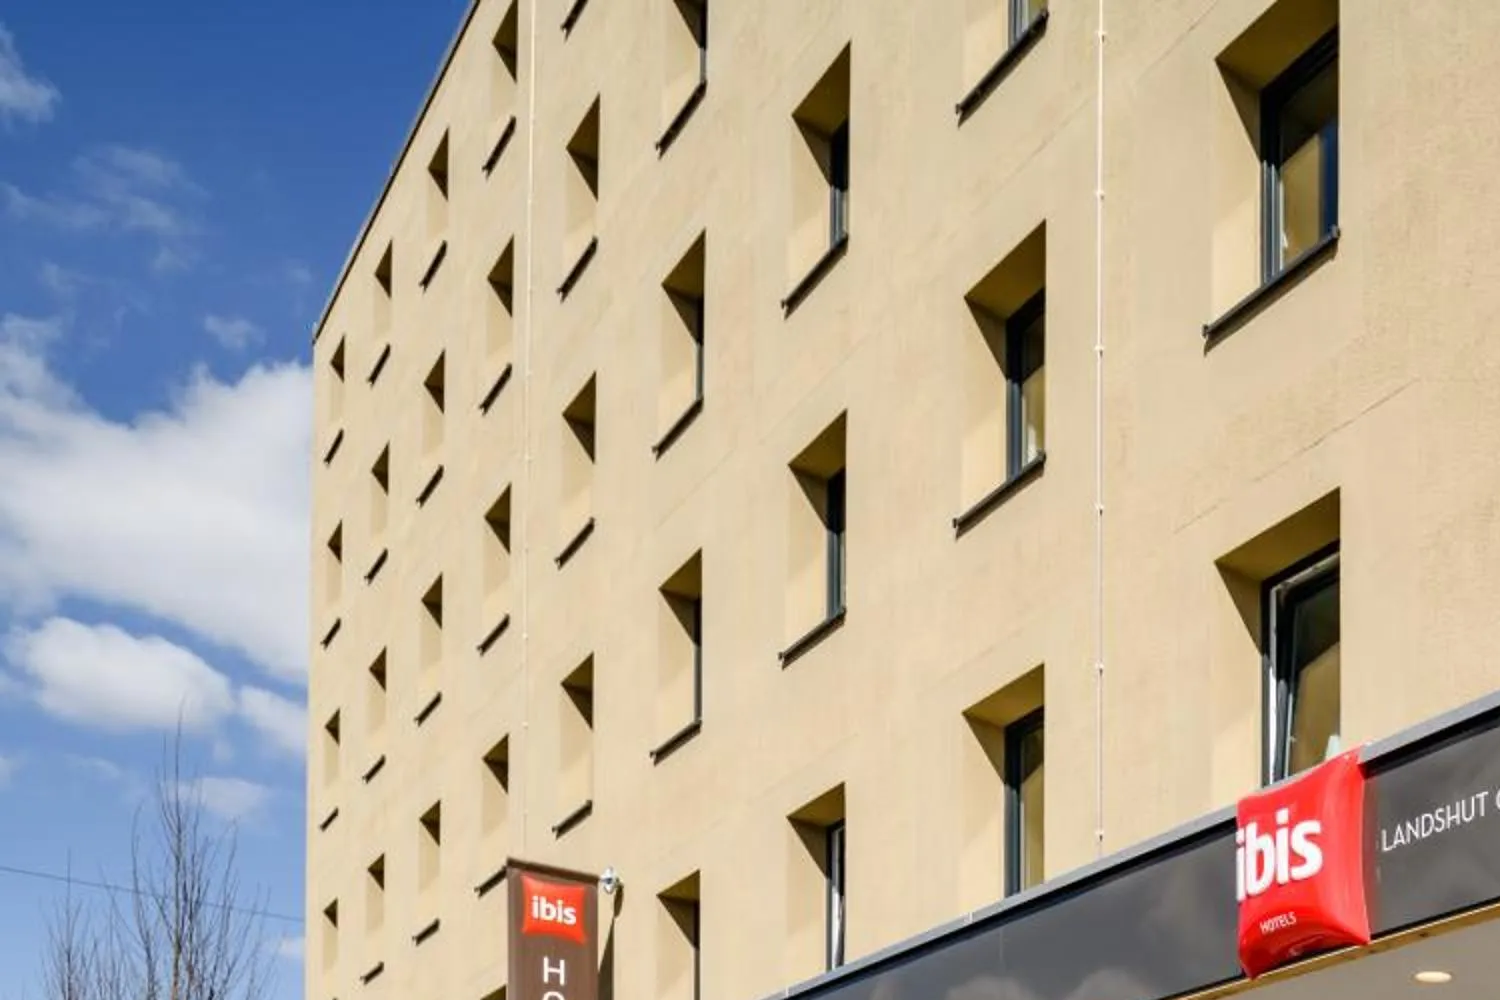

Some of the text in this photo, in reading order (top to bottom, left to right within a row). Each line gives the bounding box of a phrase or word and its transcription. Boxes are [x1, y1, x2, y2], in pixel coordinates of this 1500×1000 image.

[1381, 791, 1489, 852] LANDSHUT
[1236, 807, 1324, 901] ibis
[532, 895, 578, 926] ibis
[1259, 911, 1297, 934] HOTELS
